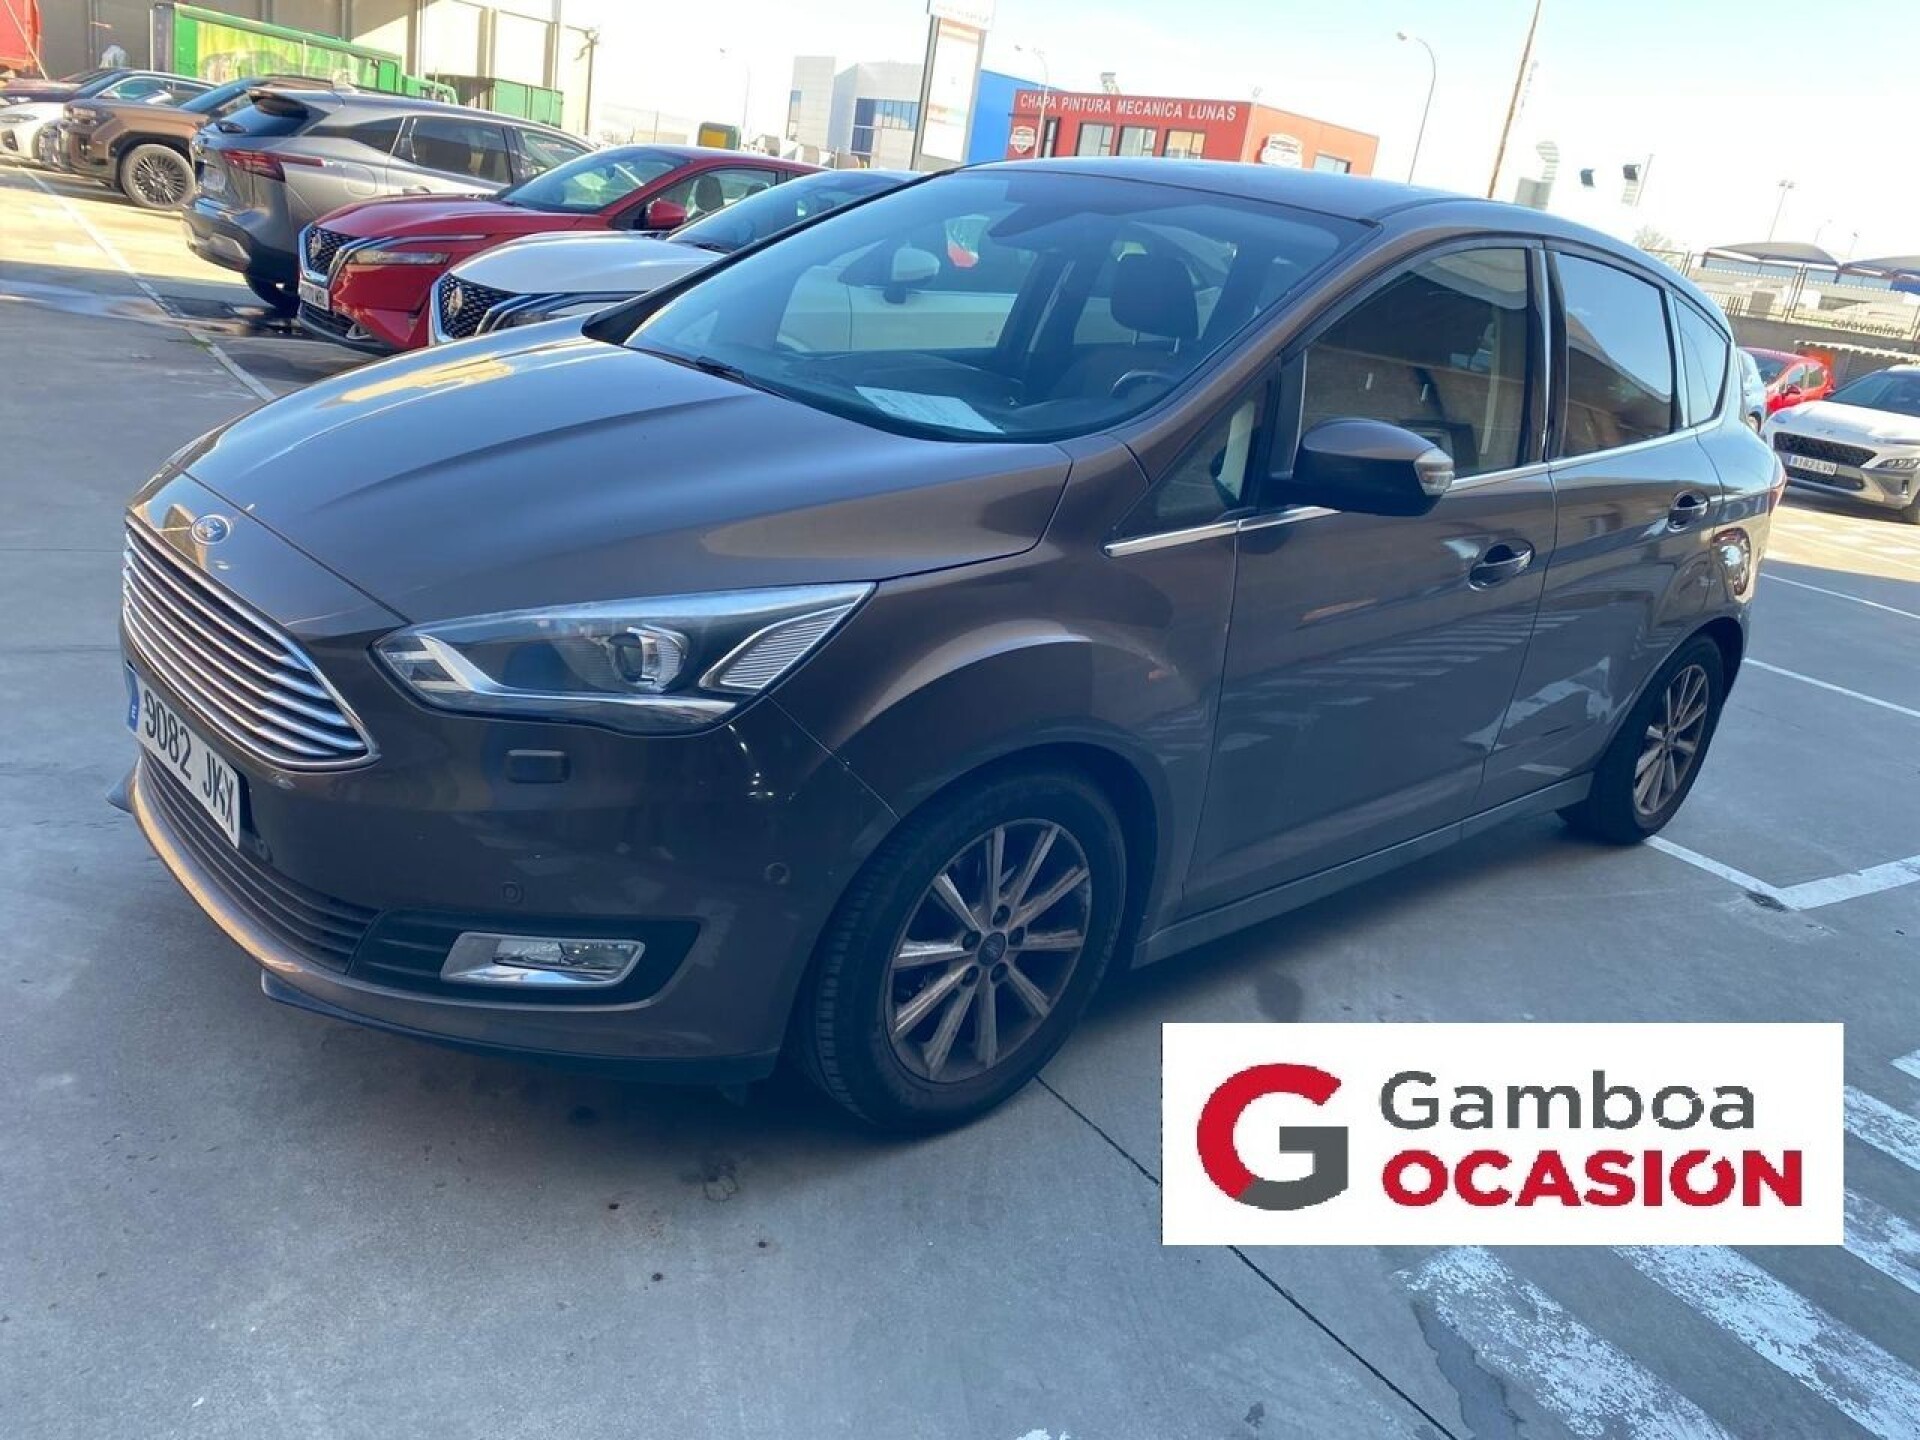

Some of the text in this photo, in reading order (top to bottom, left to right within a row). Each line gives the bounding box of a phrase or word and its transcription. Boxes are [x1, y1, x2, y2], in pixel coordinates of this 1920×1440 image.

[1020, 93, 1237, 121] CHAPA PINTURA MECANICA LUNAS
[144, 689, 235, 834] 9082 JKX
